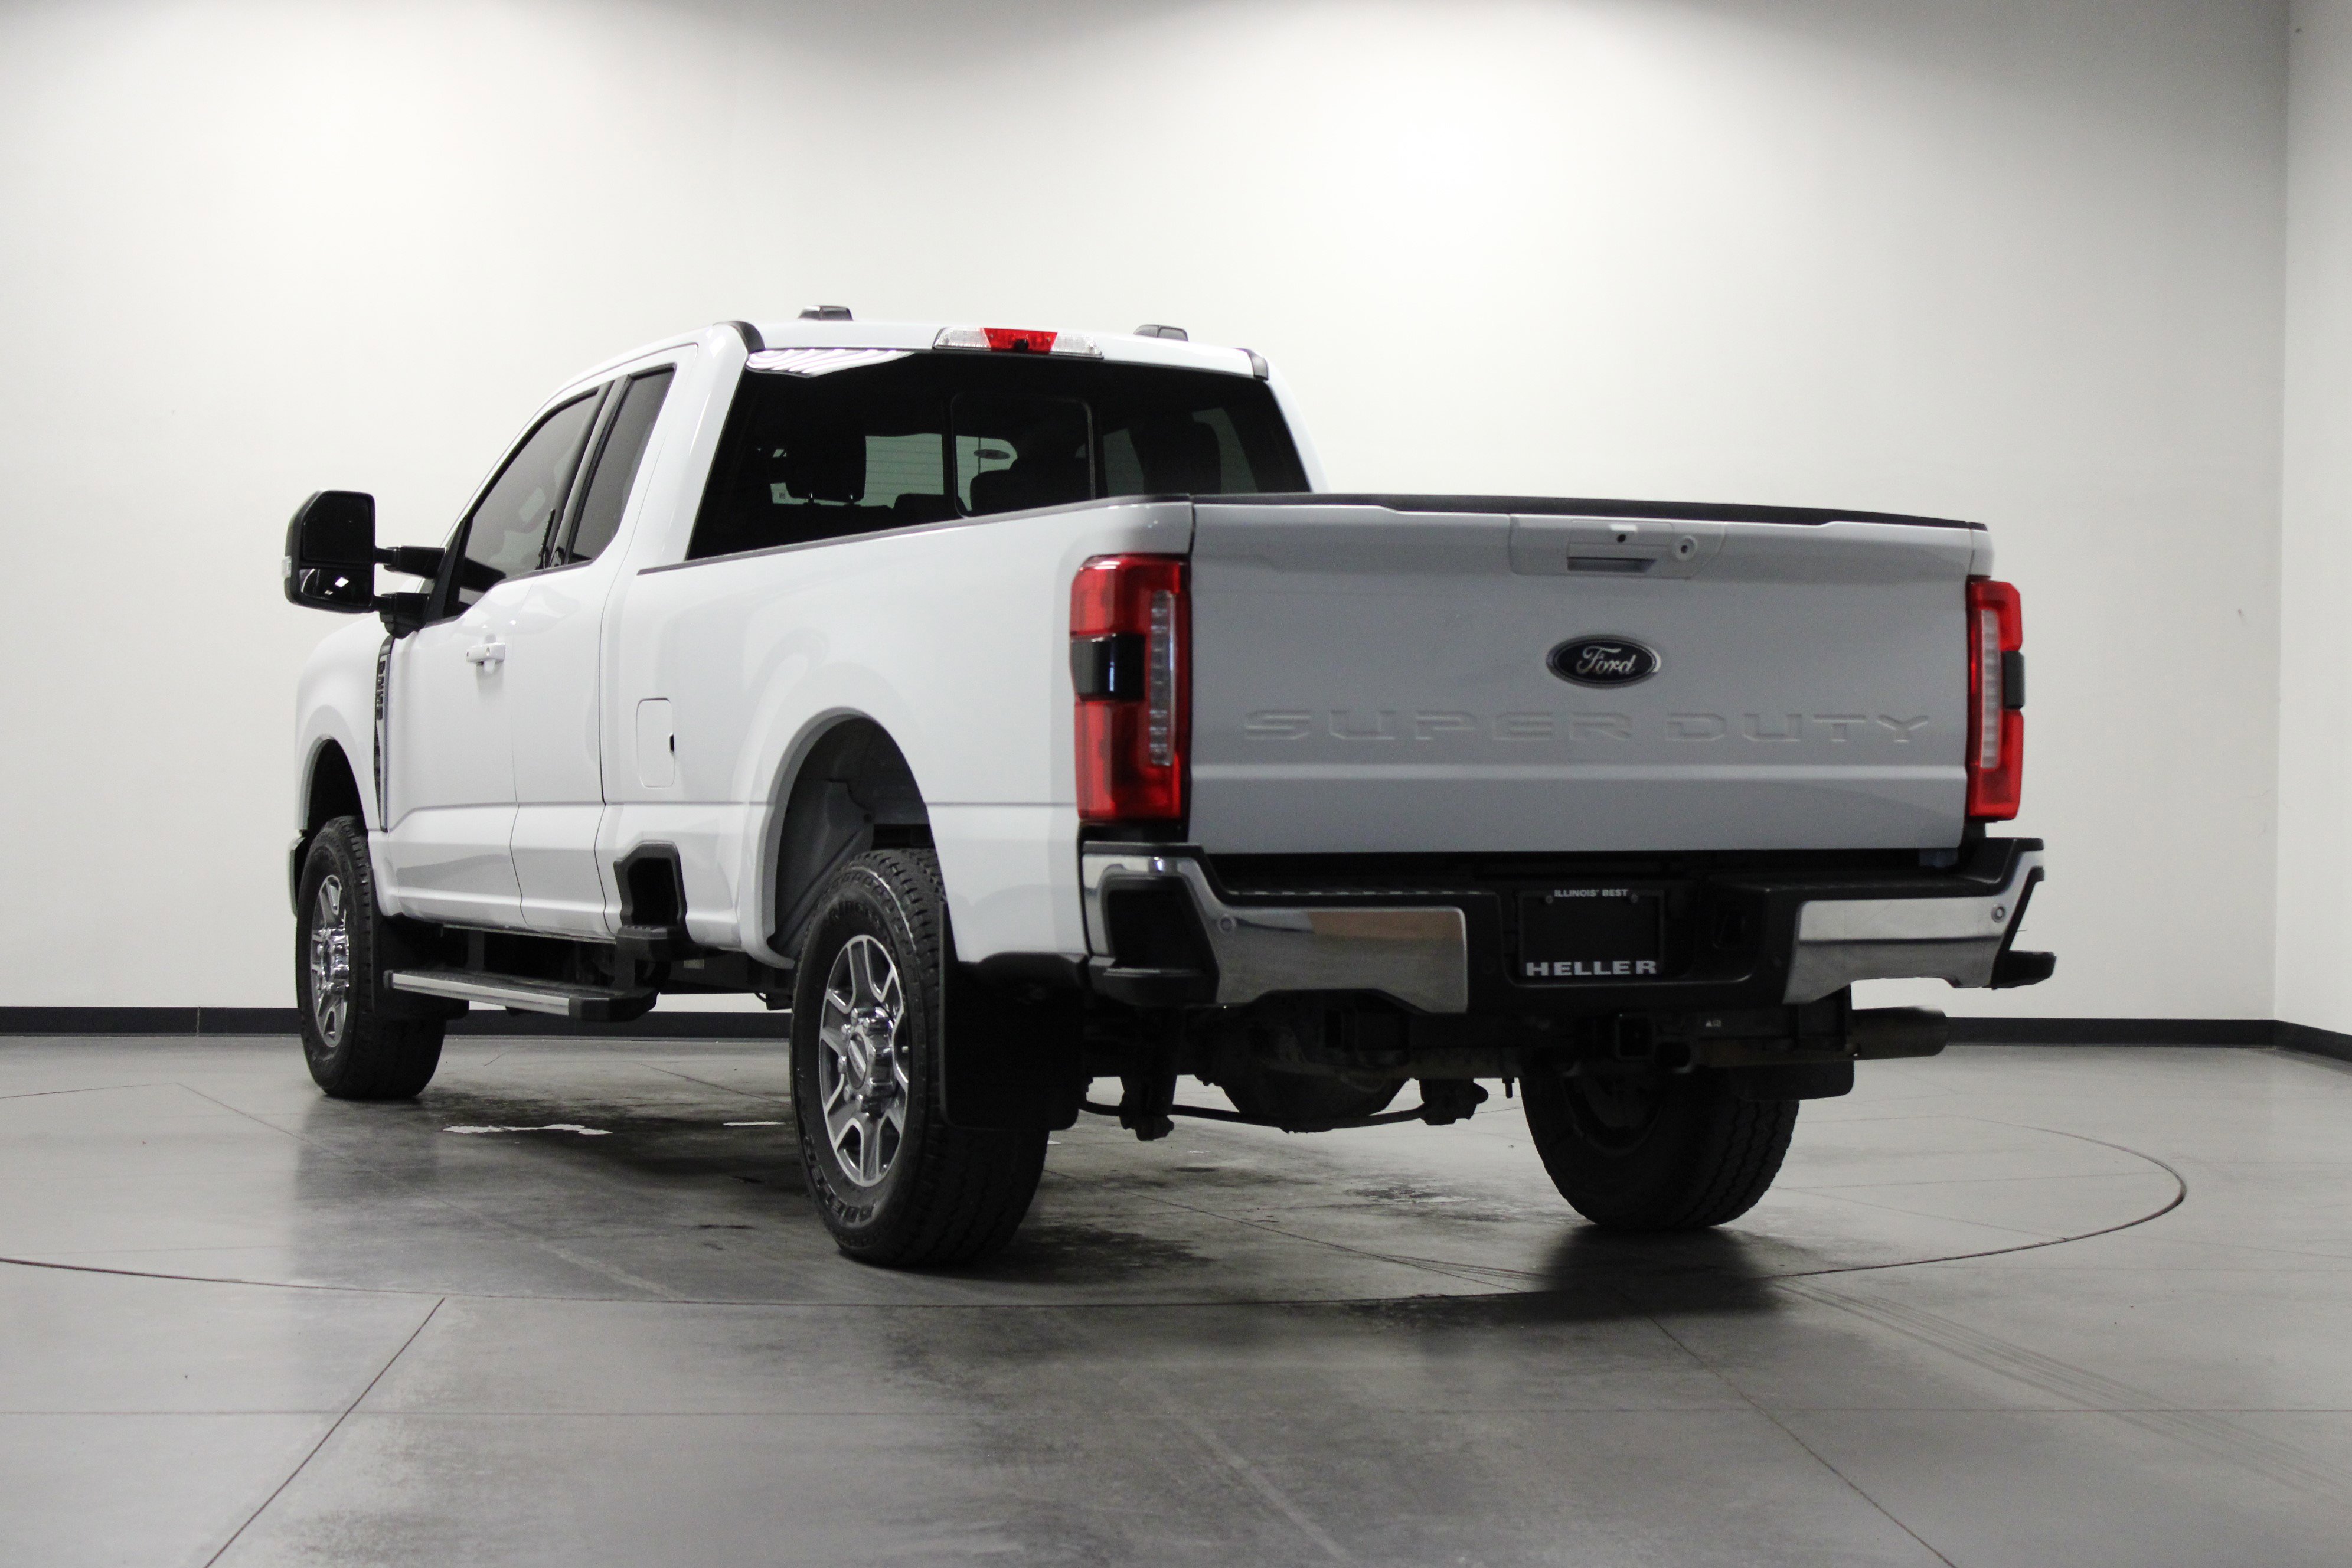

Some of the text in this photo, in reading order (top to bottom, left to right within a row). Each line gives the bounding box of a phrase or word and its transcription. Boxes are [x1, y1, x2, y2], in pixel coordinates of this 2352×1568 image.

[1576, 645, 1637, 674] Ford
[1243, 710, 1930, 743] SUPER DUTY
[1526, 960, 1657, 976] HELLER
